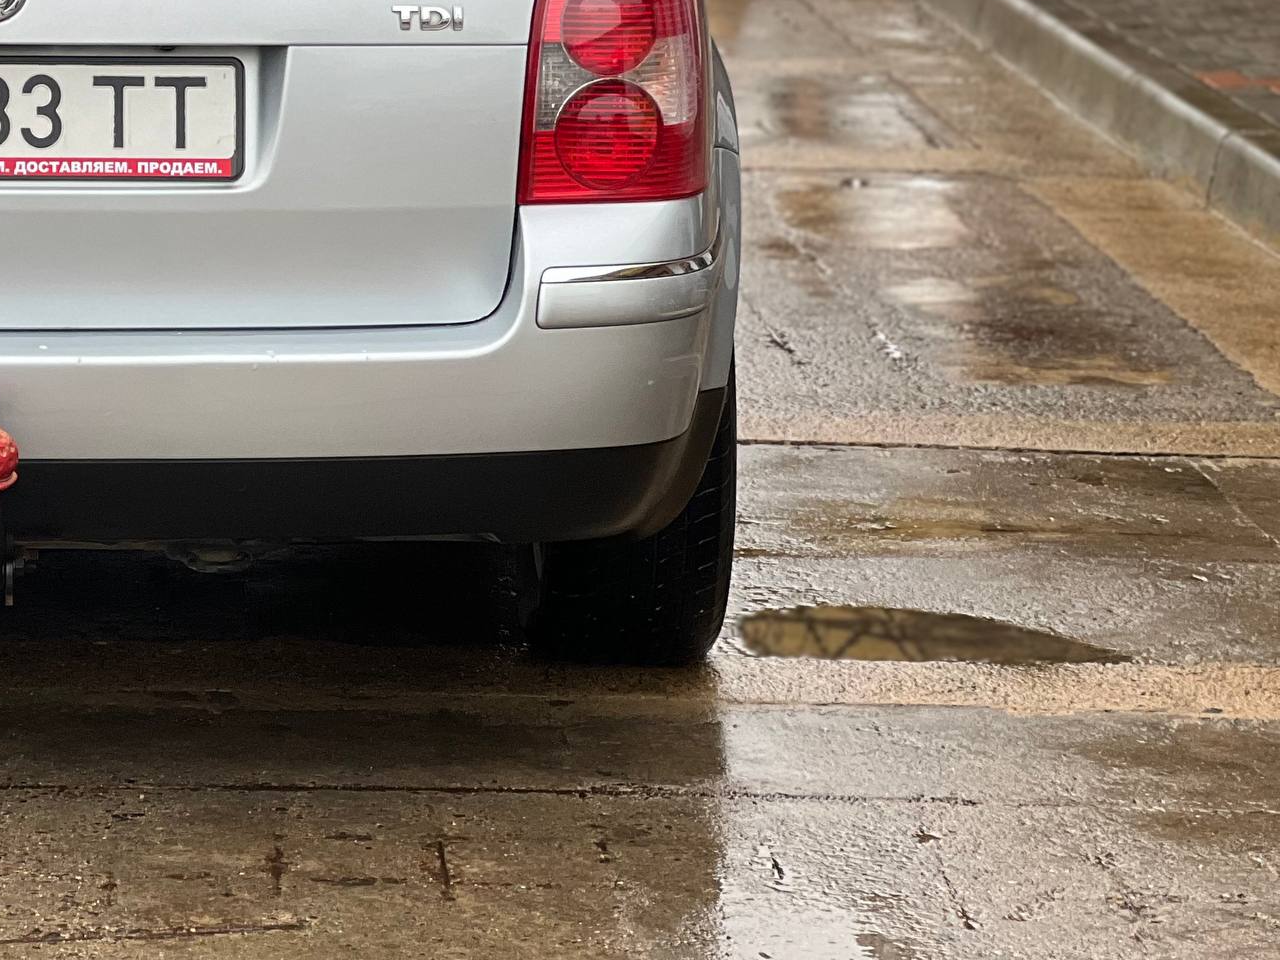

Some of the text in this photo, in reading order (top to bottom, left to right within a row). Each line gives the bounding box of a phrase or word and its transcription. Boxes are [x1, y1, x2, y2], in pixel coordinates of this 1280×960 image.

[391, 5, 464, 31] TDI
[93, 76, 206, 149] TT
[14, 160, 132, 176] ДОСТАВЛЯЕМ.
[137, 161, 222, 176] ПРОДАЕМ.
